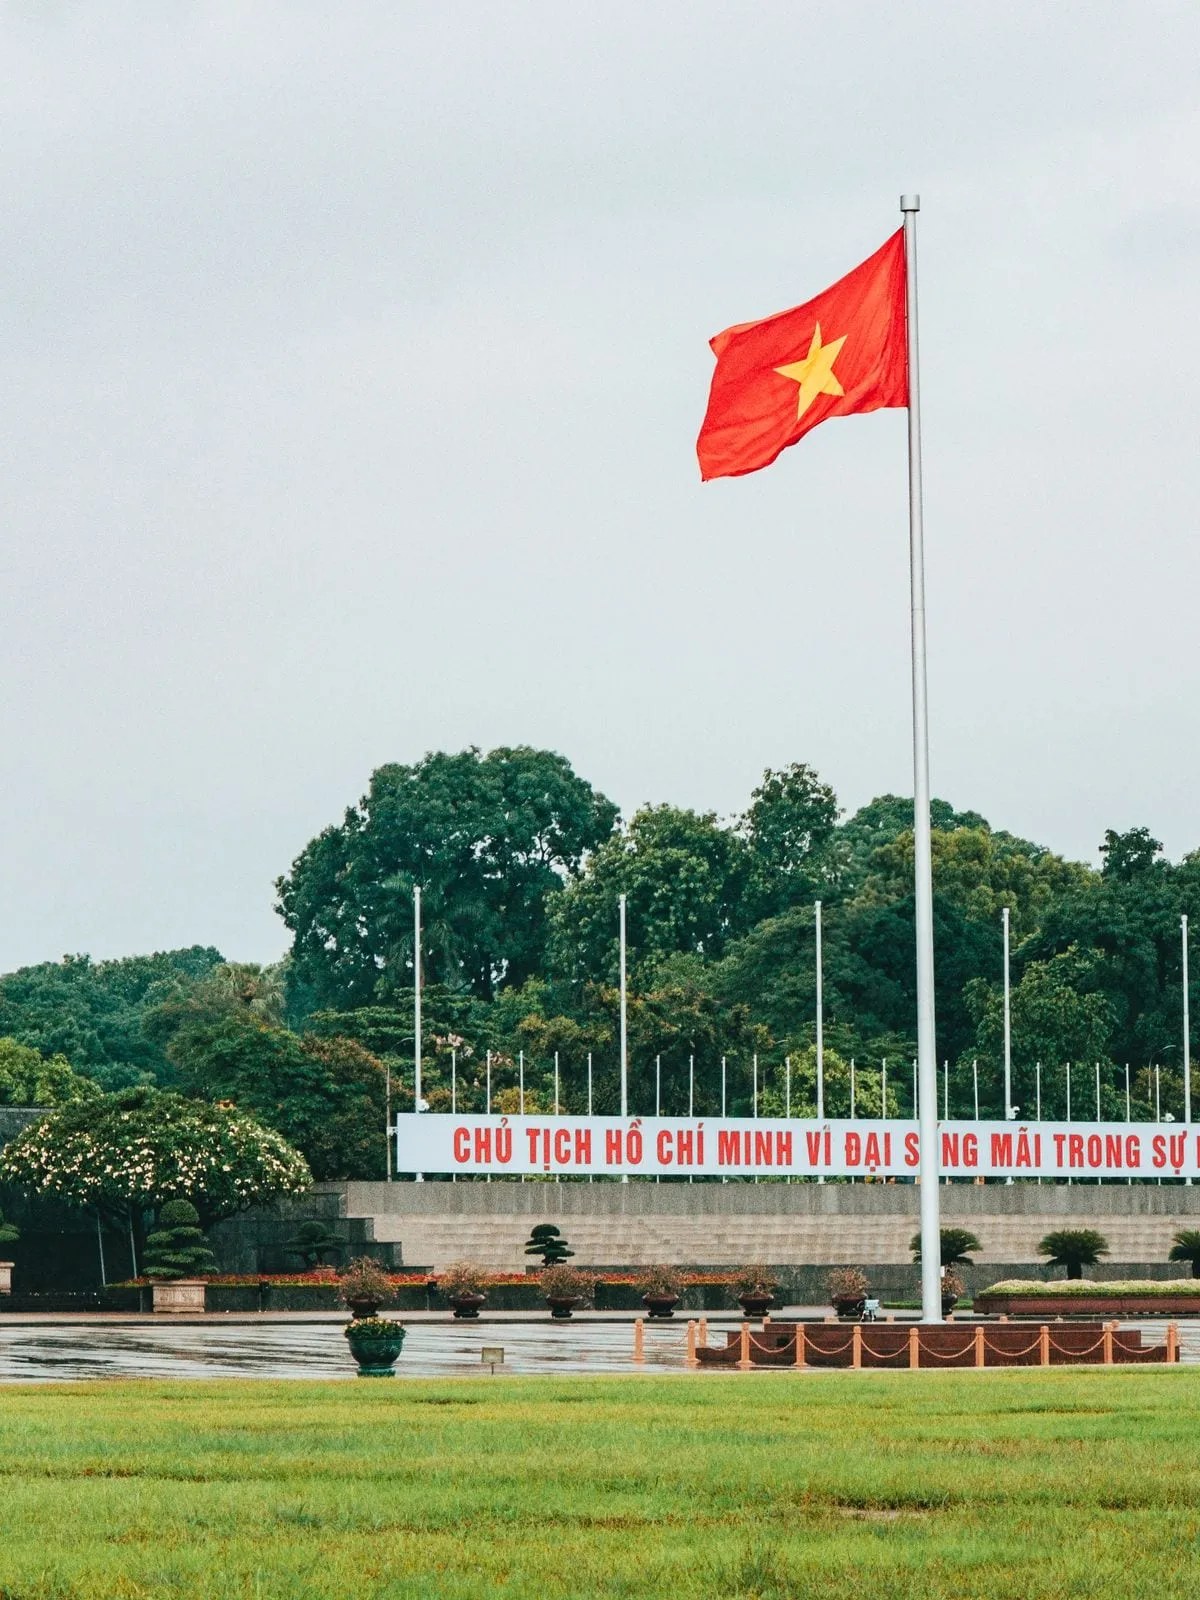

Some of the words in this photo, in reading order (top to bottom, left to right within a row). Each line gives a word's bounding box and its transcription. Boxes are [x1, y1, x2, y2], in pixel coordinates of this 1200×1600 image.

[453, 1117, 513, 1164] CHỦ
[526, 1128, 592, 1171] TỊCH
[605, 1118, 643, 1165] HỒ
[656, 1122, 705, 1166] CHÍ
[718, 1130, 793, 1166] MINH
[844, 1131, 891, 1172] ĐẠI
[904, 1123, 978, 1168] SNG
[990, 1126, 1041, 1168] MÃI
[1053, 1133, 1141, 1168] TRONG
[1151, 1130, 1187, 1174] SỰ
